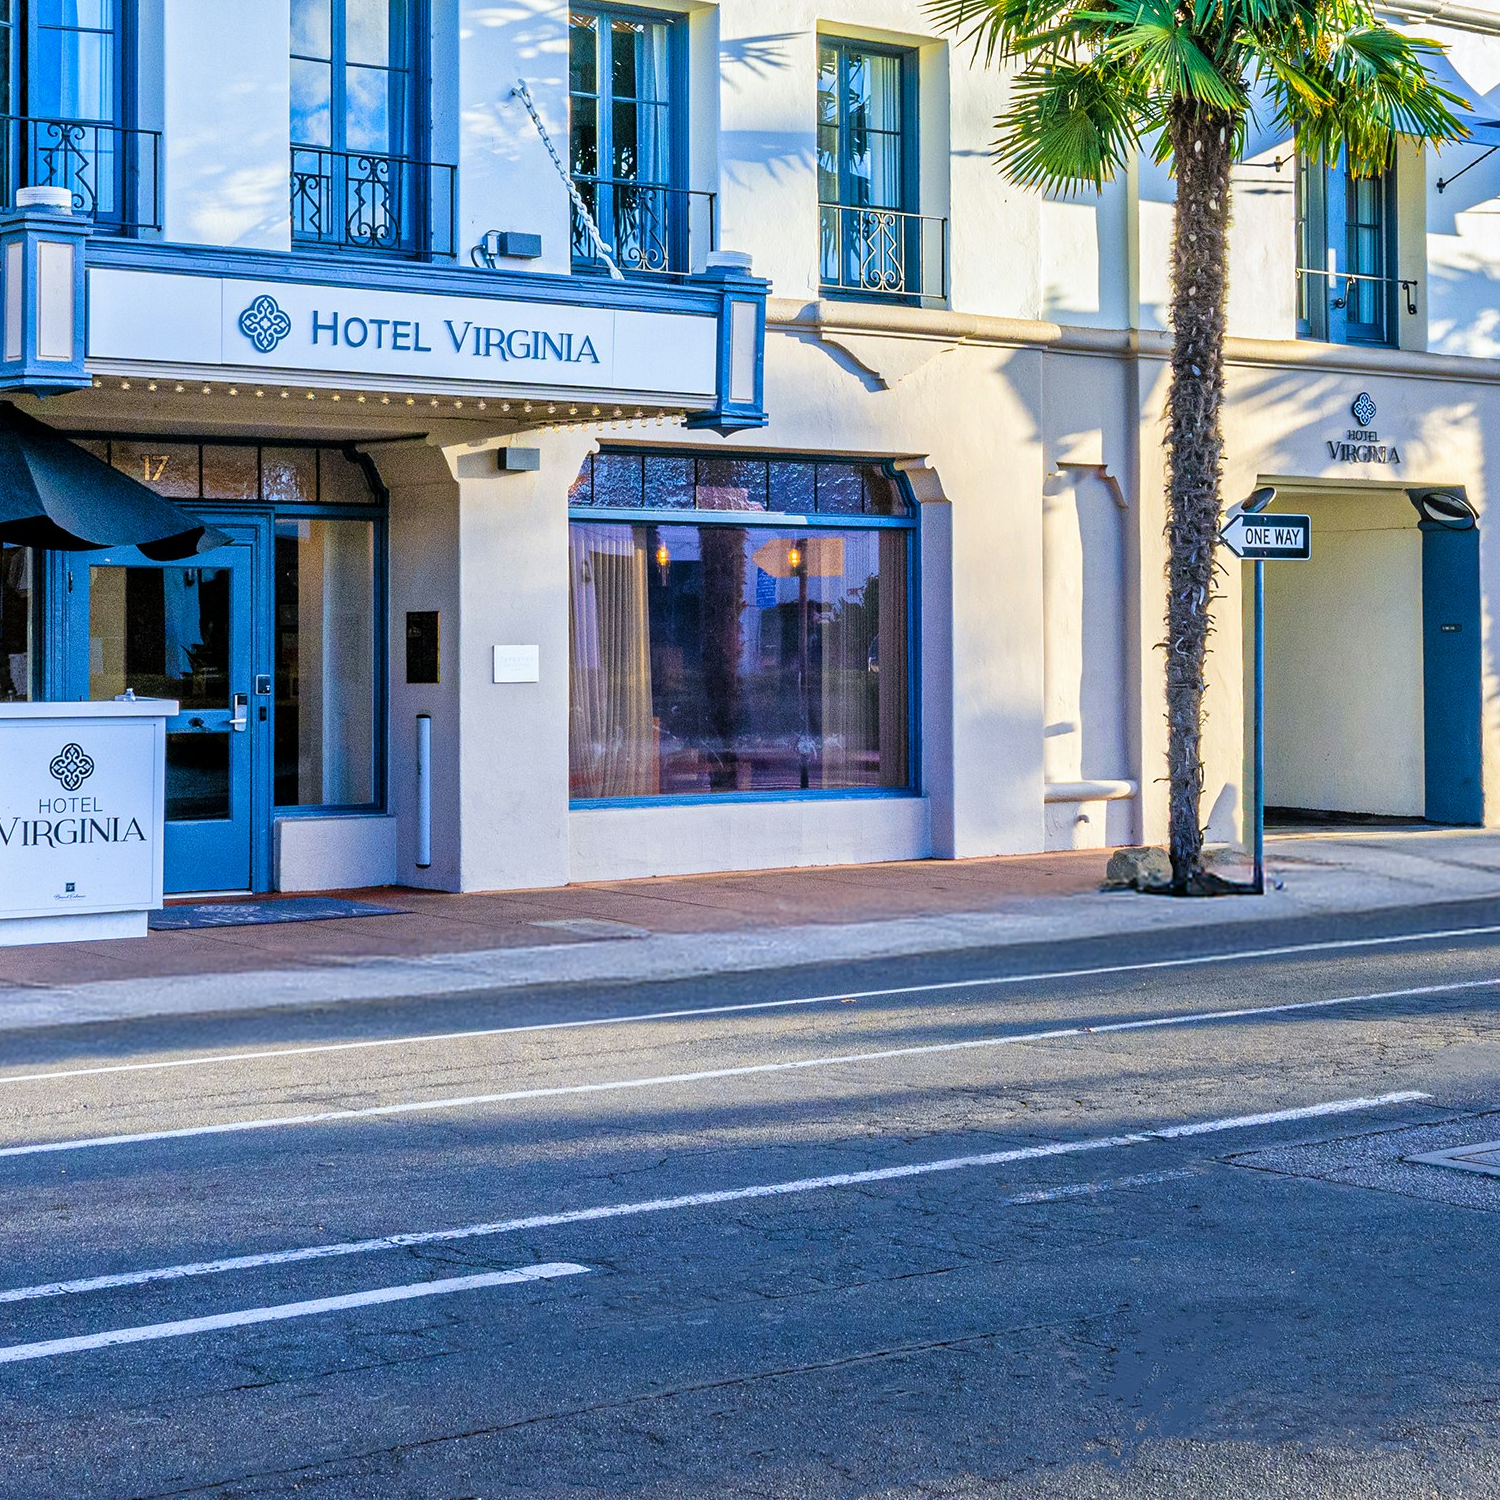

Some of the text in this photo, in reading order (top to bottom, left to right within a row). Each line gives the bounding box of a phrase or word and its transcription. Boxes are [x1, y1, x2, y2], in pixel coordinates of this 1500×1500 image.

[311, 310, 601, 364] HOTEL VIRGINIA
[1347, 430, 1380, 443] HOTEL
[1327, 440, 1401, 465] VIRGINIA
[140, 454, 171, 481] 17
[1245, 528, 1301, 546] ONE WAY
[38, 797, 103, 814] HOTEL
